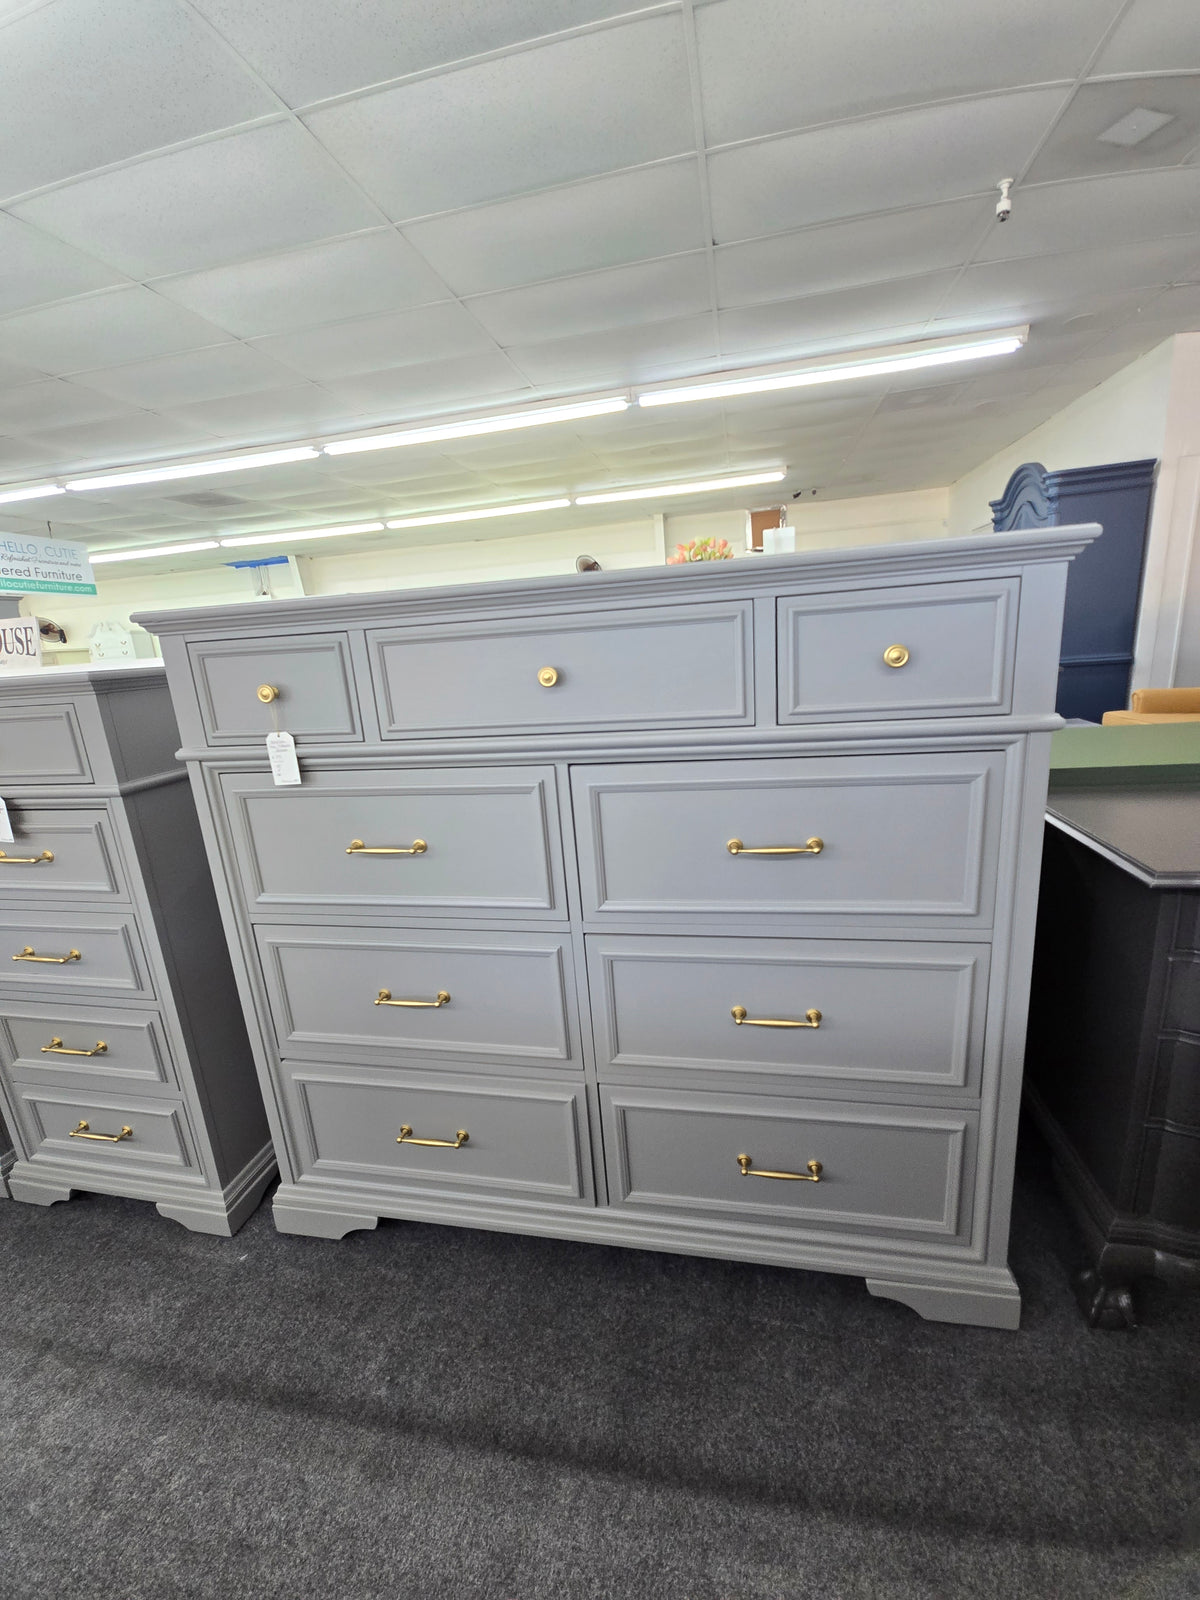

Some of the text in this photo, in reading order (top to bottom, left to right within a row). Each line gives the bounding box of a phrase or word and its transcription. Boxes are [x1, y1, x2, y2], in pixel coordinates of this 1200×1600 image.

[0, 541, 79, 560] HELLO CUTIE
[0, 566, 83, 581] ered Furniture
